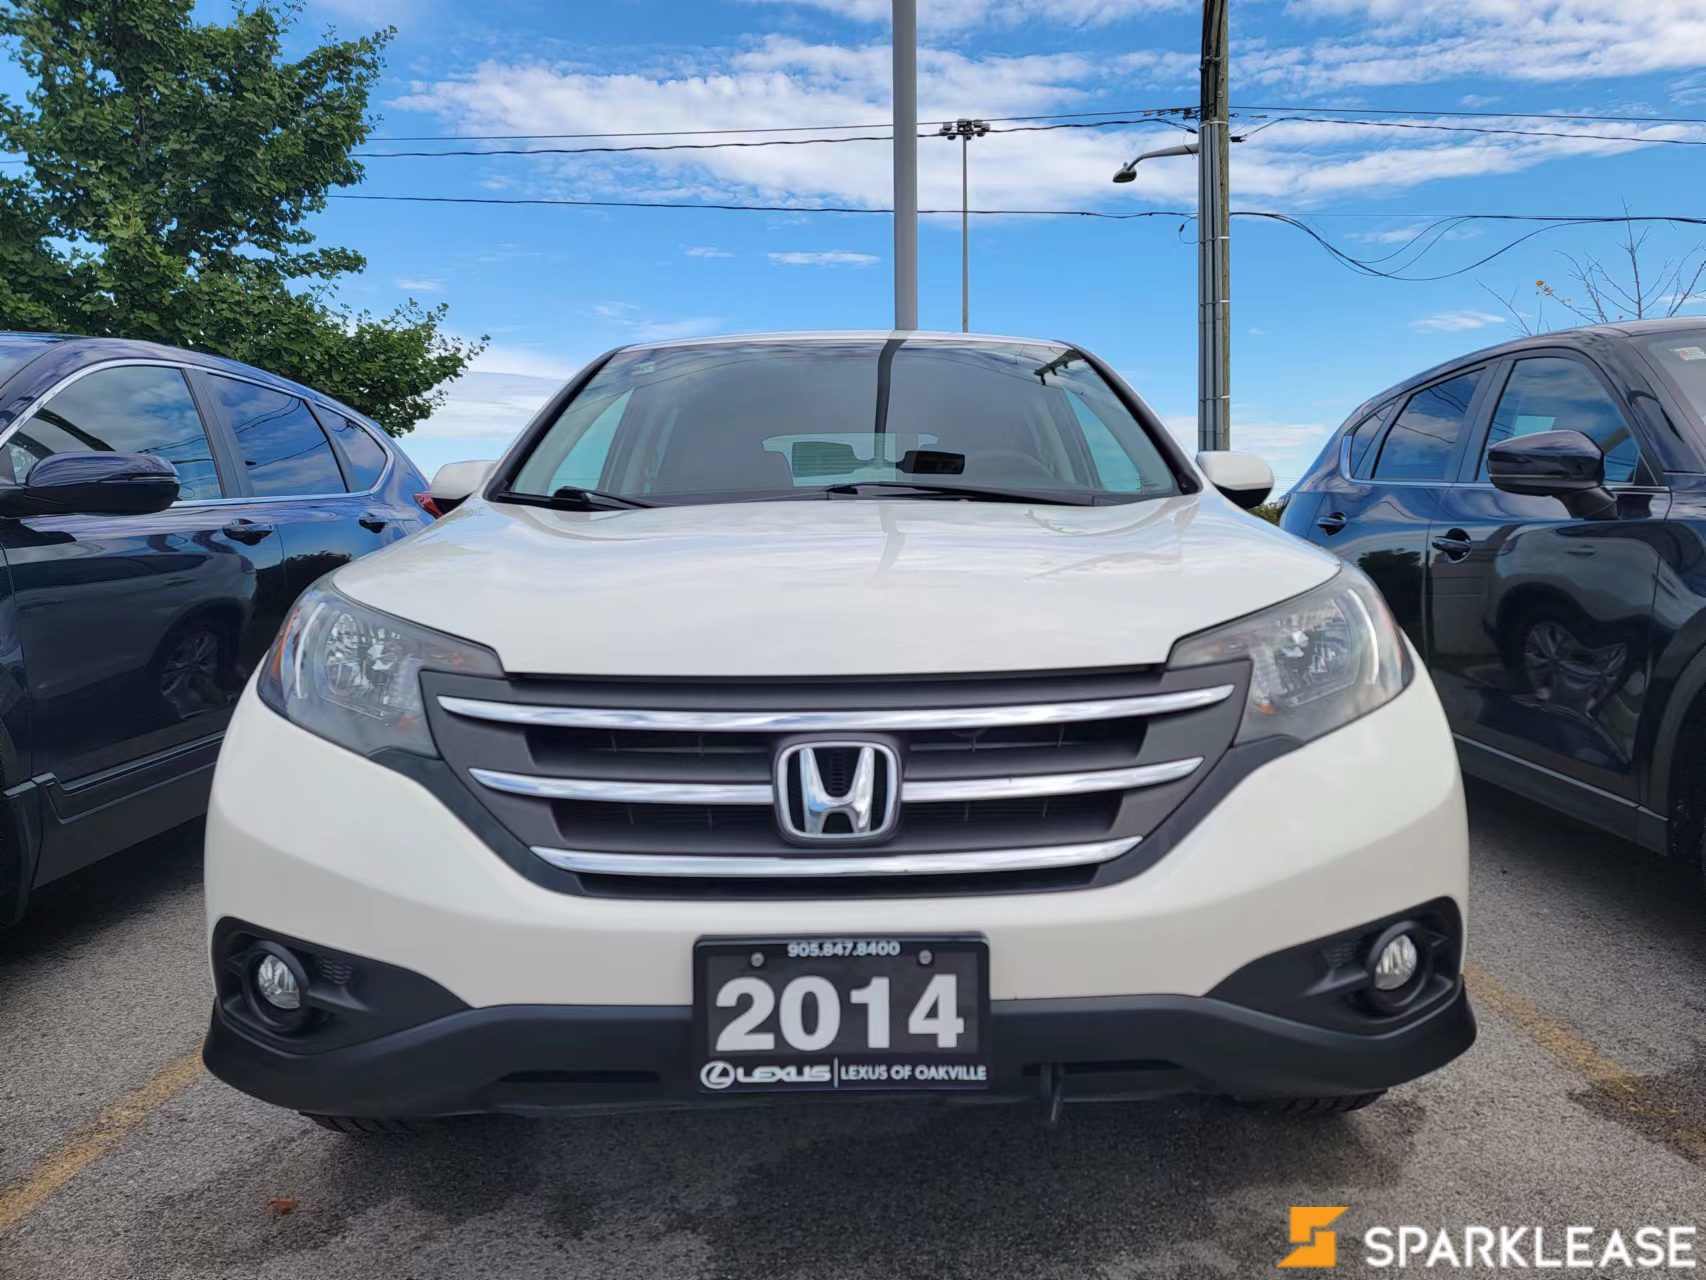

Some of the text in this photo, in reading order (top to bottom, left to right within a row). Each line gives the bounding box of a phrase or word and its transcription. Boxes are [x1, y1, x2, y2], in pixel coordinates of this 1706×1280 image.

[787, 941, 901, 957] 905.847.8400
[716, 974, 964, 1051] 2014
[736, 1066, 832, 1082] LEXUS
[840, 1064, 987, 1080] LEXUS OF OAKVILLE
